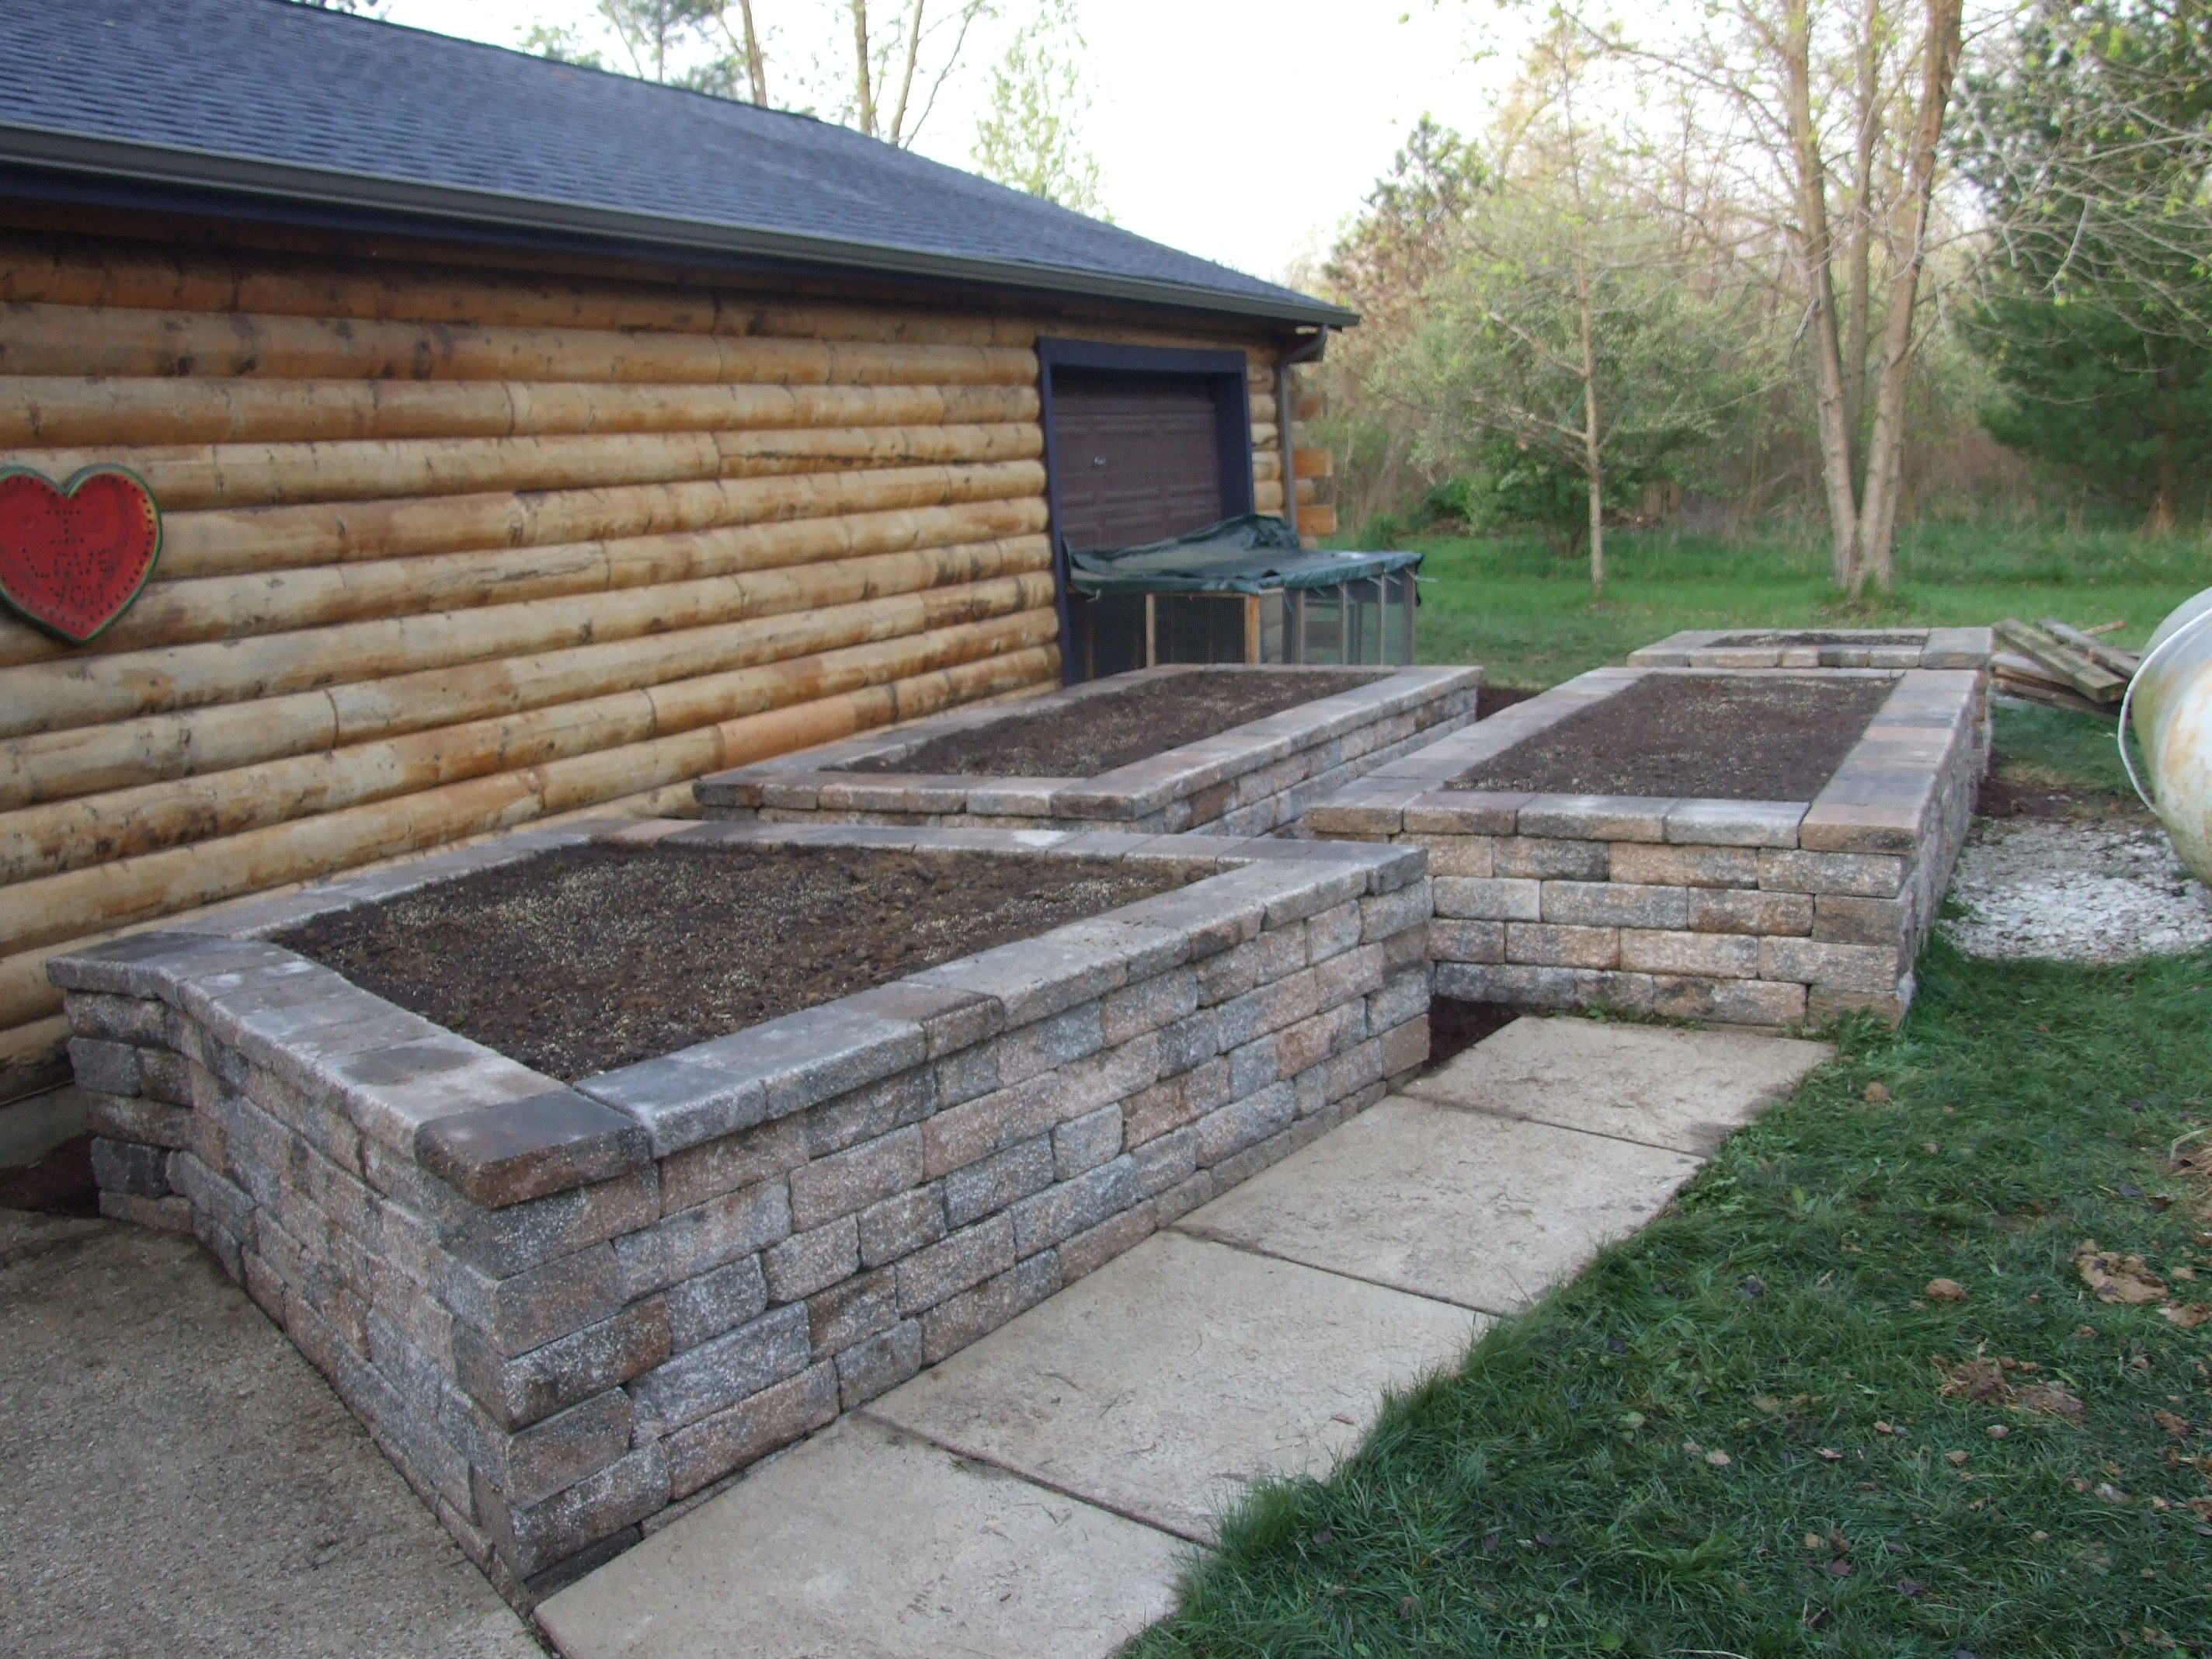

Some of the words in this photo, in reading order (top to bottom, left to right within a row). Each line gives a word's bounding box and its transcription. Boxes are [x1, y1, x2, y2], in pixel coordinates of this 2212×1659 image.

[46, 510, 85, 545] I
[22, 547, 117, 579] LOVE
[49, 583, 104, 610] YOU
